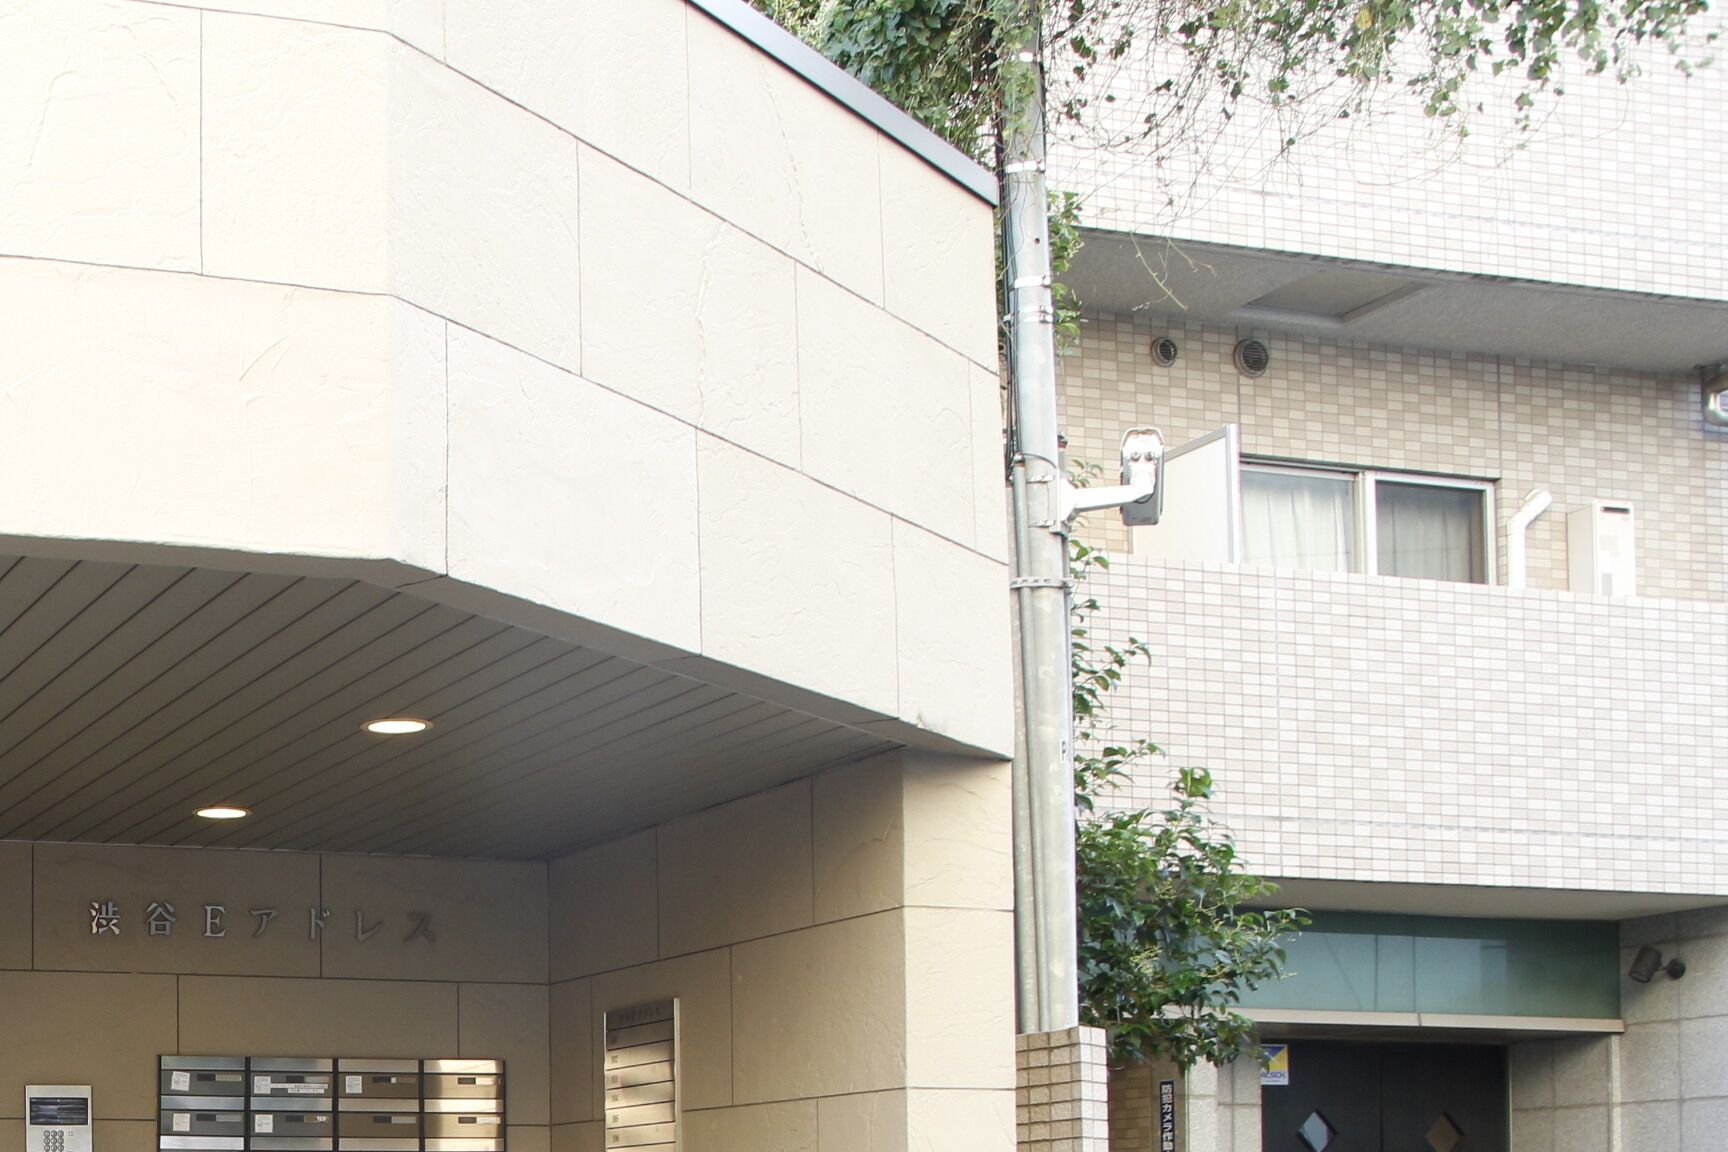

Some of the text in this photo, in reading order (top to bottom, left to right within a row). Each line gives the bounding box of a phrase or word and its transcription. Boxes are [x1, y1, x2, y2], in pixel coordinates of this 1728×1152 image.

[88, 901, 438, 945] 渋谷Eアドレス
